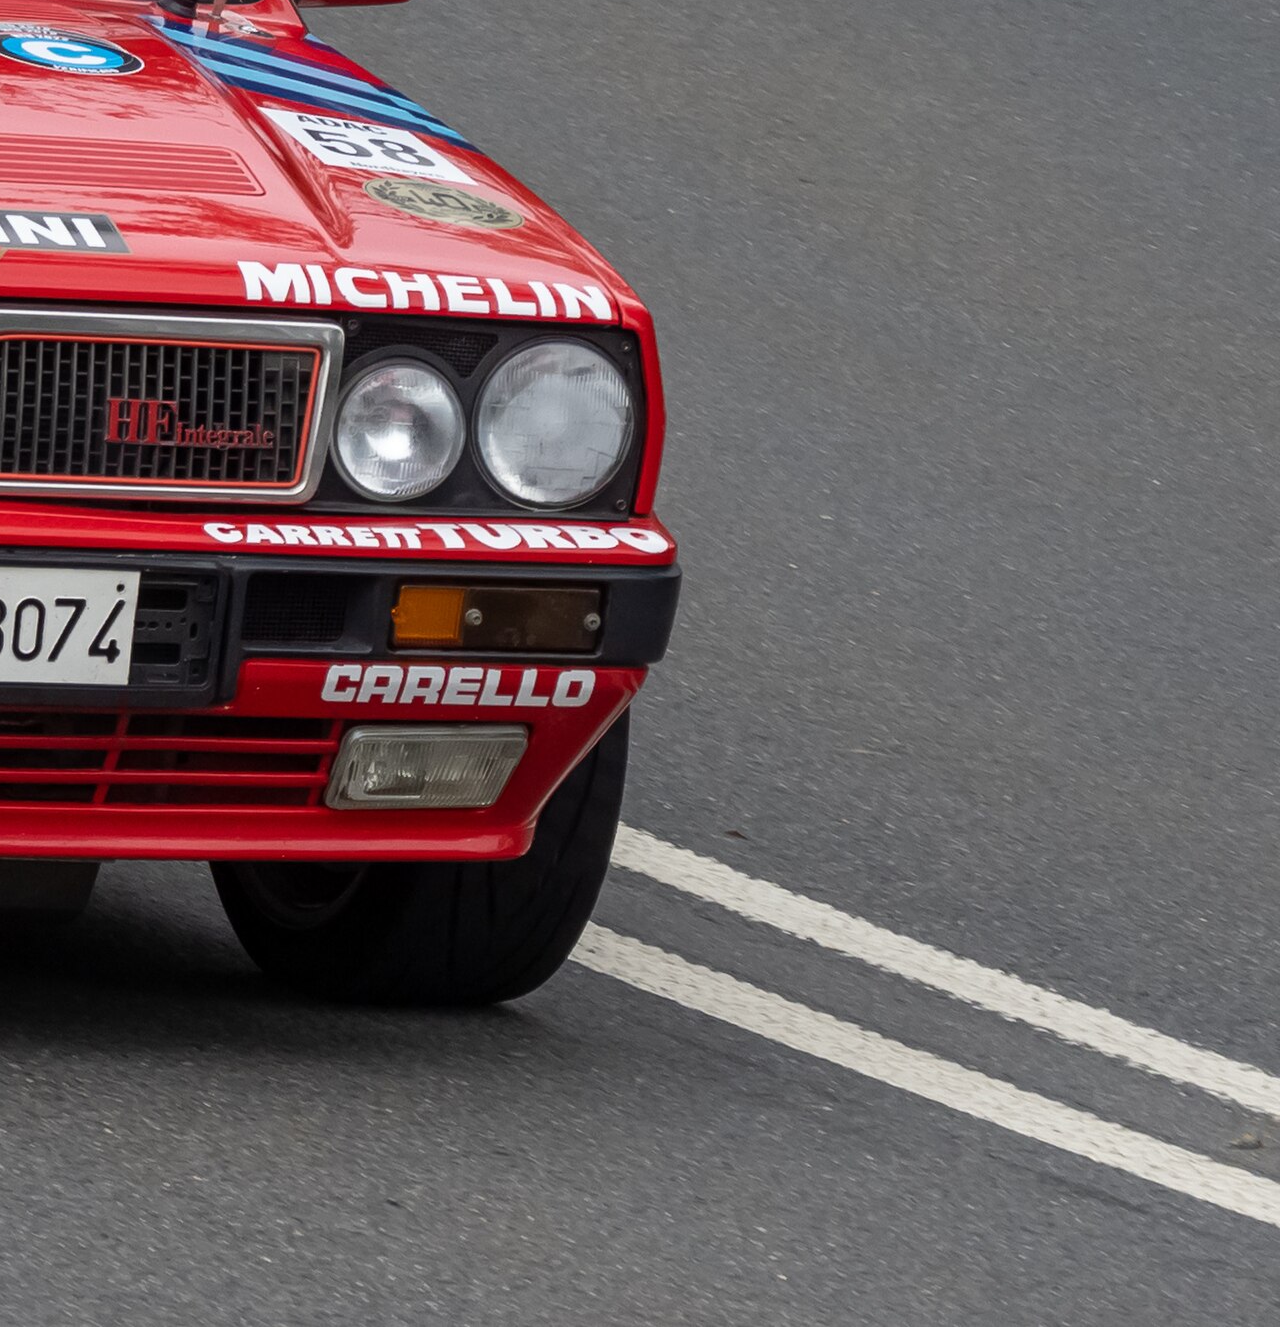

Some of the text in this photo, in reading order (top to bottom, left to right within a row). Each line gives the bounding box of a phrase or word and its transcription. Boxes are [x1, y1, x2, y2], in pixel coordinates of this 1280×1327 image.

[21, 41, 107, 66] C
[297, 115, 388, 136] ADAC
[303, 128, 436, 167] 58
[238, 261, 613, 320] MICHELIN
[105, 398, 274, 451] HF integrale
[203, 522, 669, 554] GARRETT TURBO
[321, 664, 596, 708] CARELLO
